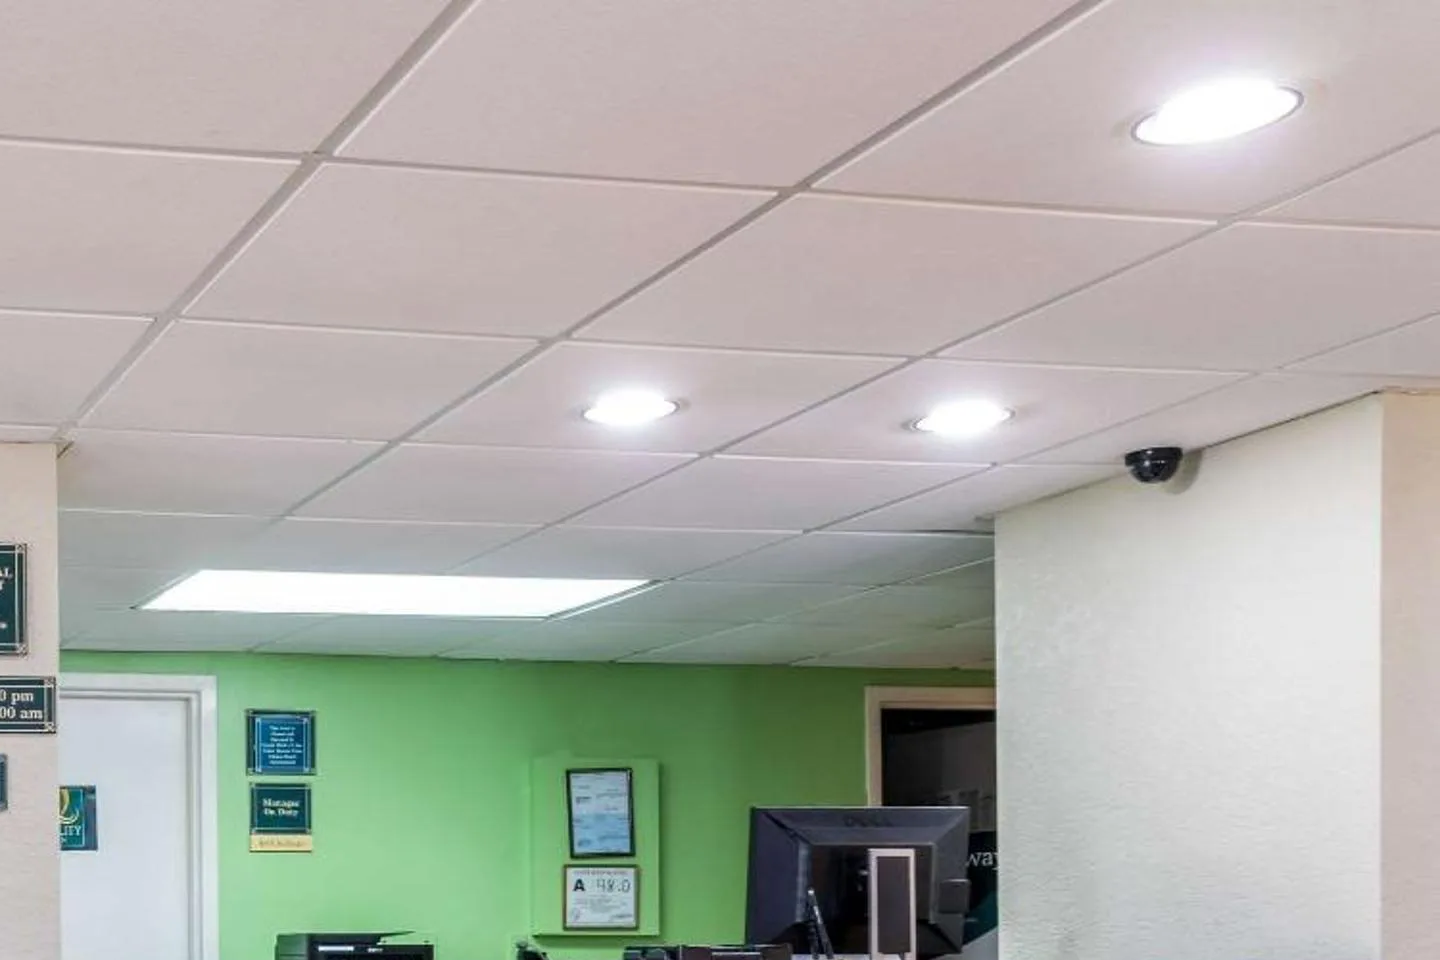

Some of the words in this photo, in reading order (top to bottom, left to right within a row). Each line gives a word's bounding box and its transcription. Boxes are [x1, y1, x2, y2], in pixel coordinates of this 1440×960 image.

[10, 691, 34, 705] pm
[19, 708, 44, 720] am
[573, 878, 587, 892] A
